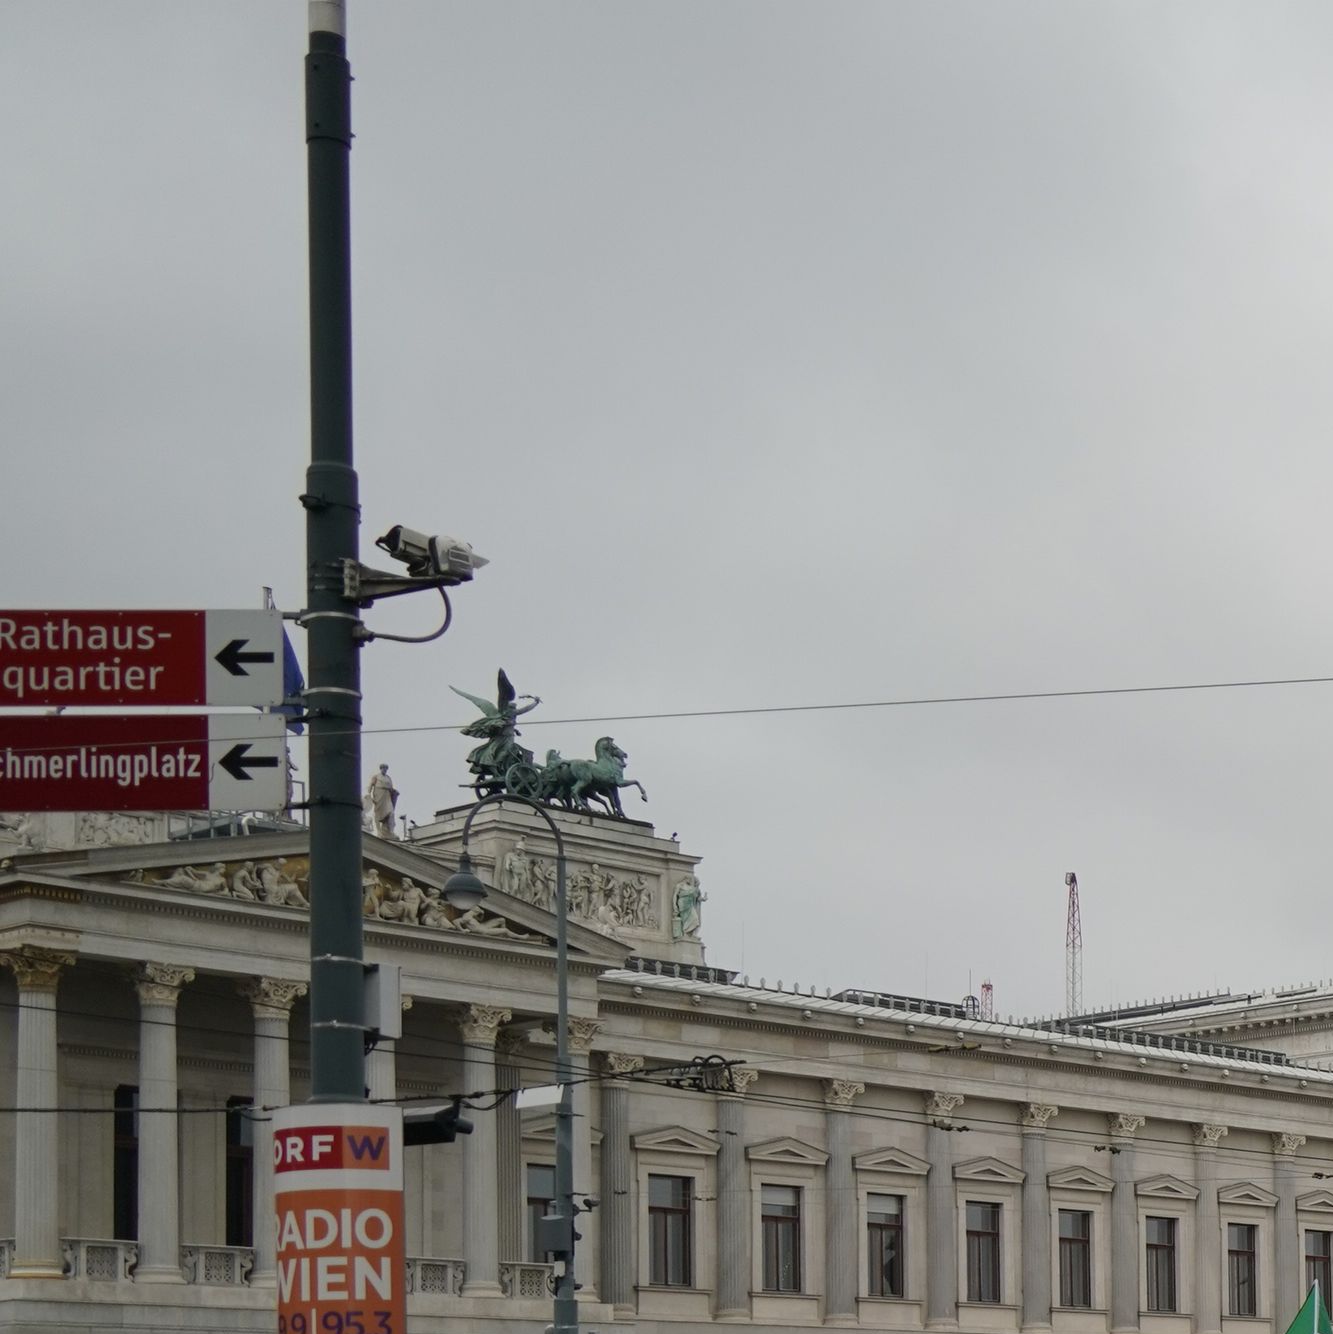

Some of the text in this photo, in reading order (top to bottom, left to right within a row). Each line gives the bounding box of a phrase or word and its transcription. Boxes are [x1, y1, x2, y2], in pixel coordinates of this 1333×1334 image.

[0, 618, 172, 650] Rathaus-
[3, 657, 164, 698] quartier
[346, 1135, 387, 1161] W
